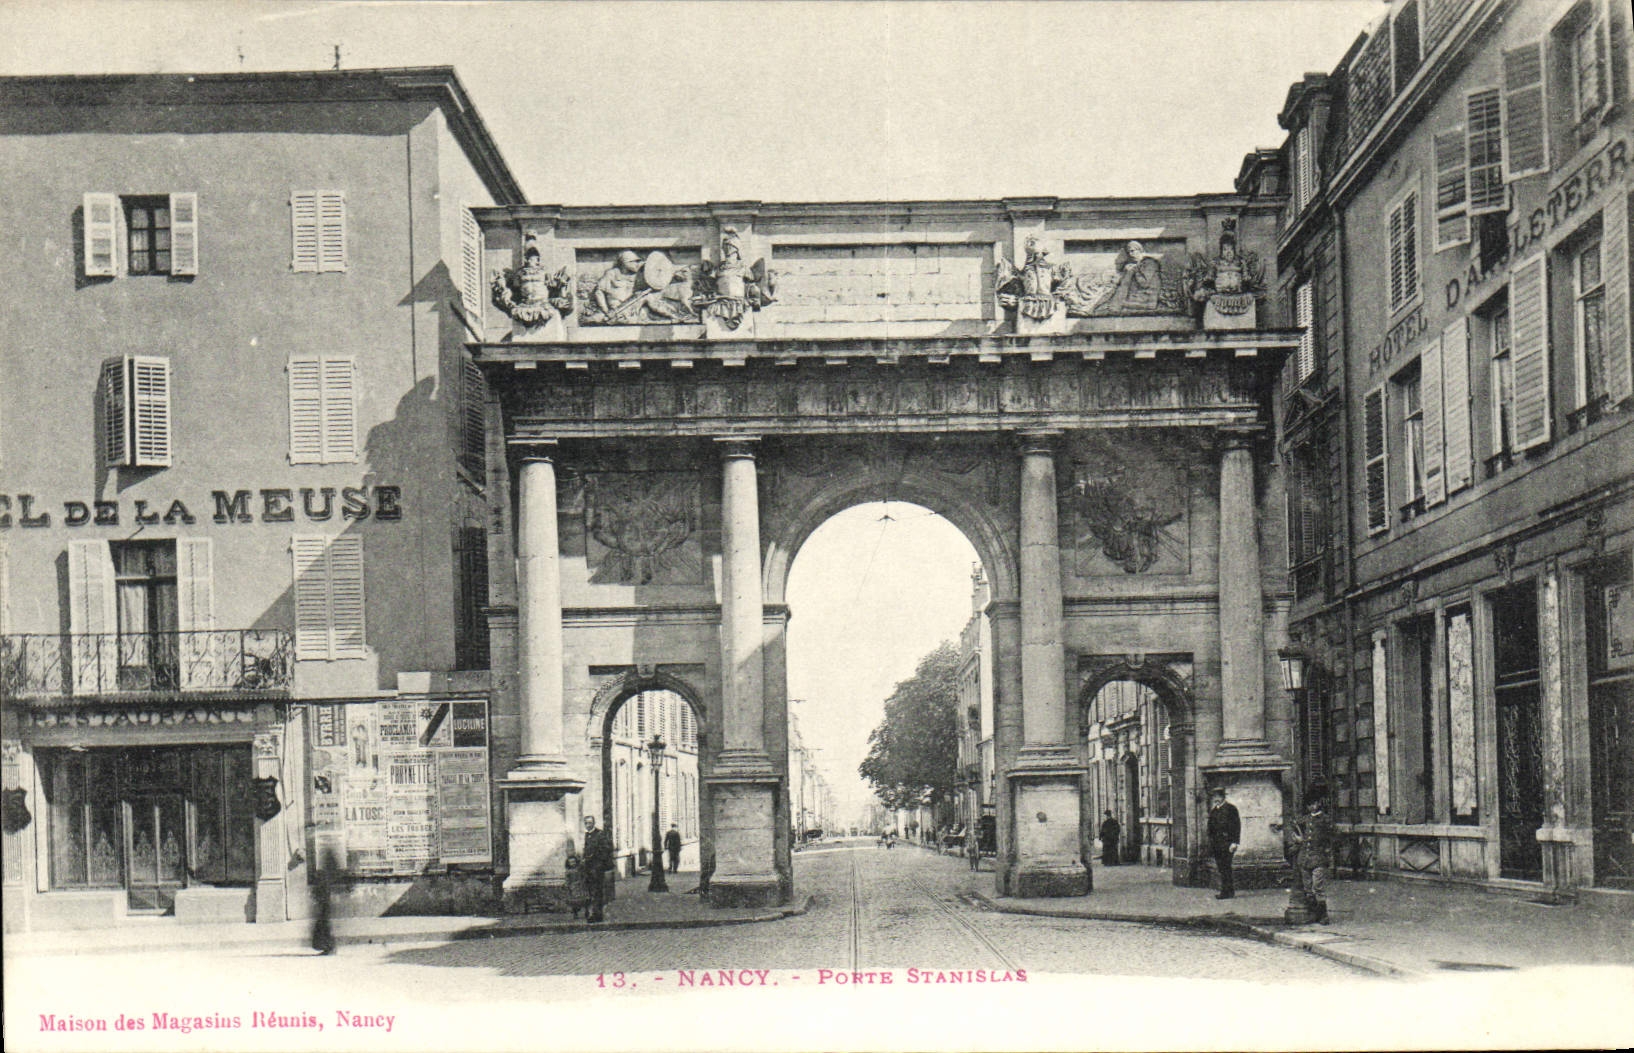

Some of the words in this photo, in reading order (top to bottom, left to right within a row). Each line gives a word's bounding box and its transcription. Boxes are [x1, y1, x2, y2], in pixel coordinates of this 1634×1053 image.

[1369, 309, 1428, 377] HOTEL
[1446, 139, 1634, 312] D'ALETERR
[64, 501, 120, 526] DE
[134, 499, 197, 525] LA
[211, 485, 402, 523] MEUSE
[32, 706, 250, 727] RESTAURANT
[320, 705, 333, 746] BYRRH
[344, 807, 357, 821] LA
